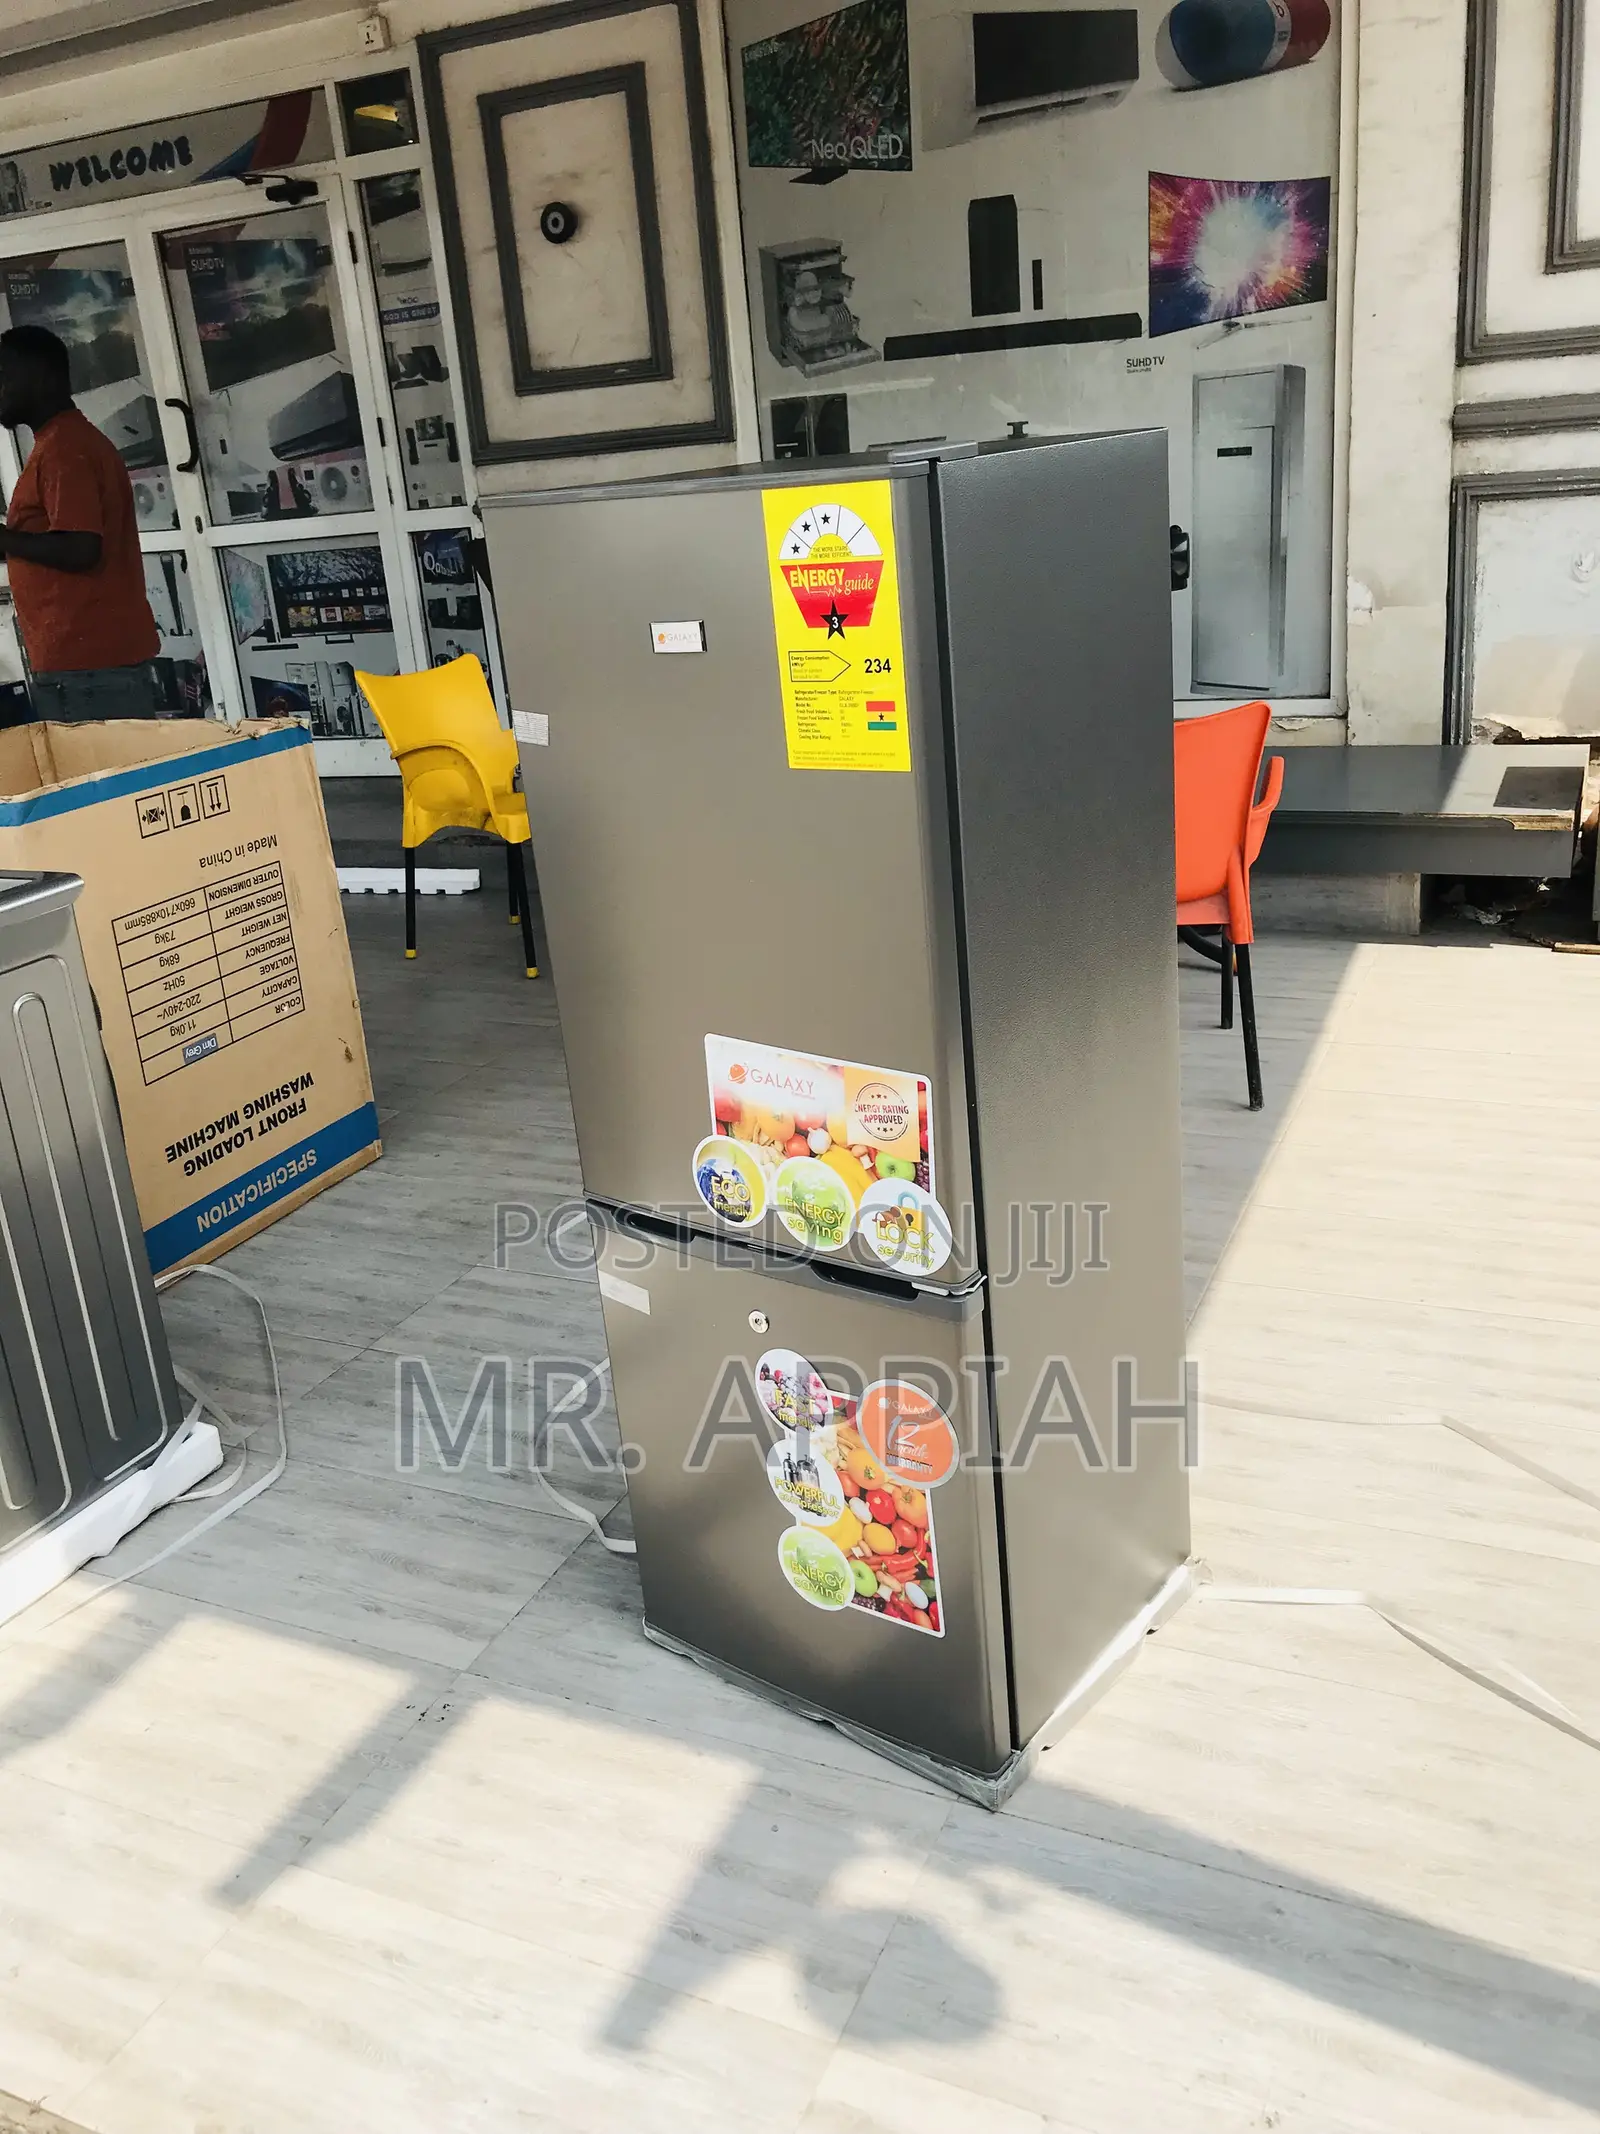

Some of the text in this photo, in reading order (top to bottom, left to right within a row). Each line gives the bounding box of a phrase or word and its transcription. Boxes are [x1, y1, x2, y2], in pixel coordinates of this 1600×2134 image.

[811, 134, 904, 160] Neo QLED
[49, 136, 193, 191] WELCOME
[789, 566, 875, 596] ENERGY guide
[831, 616, 839, 629] 3
[667, 631, 699, 642] GALAXY
[864, 658, 892, 674] 234
[199, 834, 278, 868] Made in China
[208, 869, 279, 901] OUTER DIMENSION
[124, 898, 195, 930] 660x710x885mm
[224, 891, 283, 919] GROSS WEIGHT
[154, 930, 176, 944] 73kg
[241, 911, 287, 937] NET WEIGHT
[245, 933, 291, 959] FREQUENCY
[159, 953, 180, 967] 68kg
[259, 955, 294, 976] VOLTAGE
[163, 975, 185, 991] 50Hz
[261, 975, 298, 998] CAPACITY
[275, 996, 301, 1014] COLOR
[170, 1019, 196, 1037] 11.0kg
[185, 1037, 217, 1059] Dim Grey
[750, 1068, 814, 1095] GALAXY
[165, 1072, 315, 1164] WASHING MACHINE
[863, 1114, 903, 1125] APPROVED
[882, 1105, 909, 1115] RATING
[183, 1097, 307, 1177] FRONT LOADING
[196, 1148, 318, 1233] SPECIFICATION
[711, 1175, 751, 1202] ECO
[713, 1198, 753, 1221] friendly
[784, 1197, 846, 1227] ENERGY
[787, 1216, 844, 1245] saving
[876, 1219, 936, 1254] LOCK
[877, 1244, 935, 1270] security
[775, 1388, 816, 1417] FAST
[891, 1400, 933, 1417] GALAXY
[887, 1414, 920, 1451] 12
[775, 1476, 841, 1510] POWERFUL
[791, 1560, 845, 1590] ENERGY
[794, 1576, 845, 1605] saving
